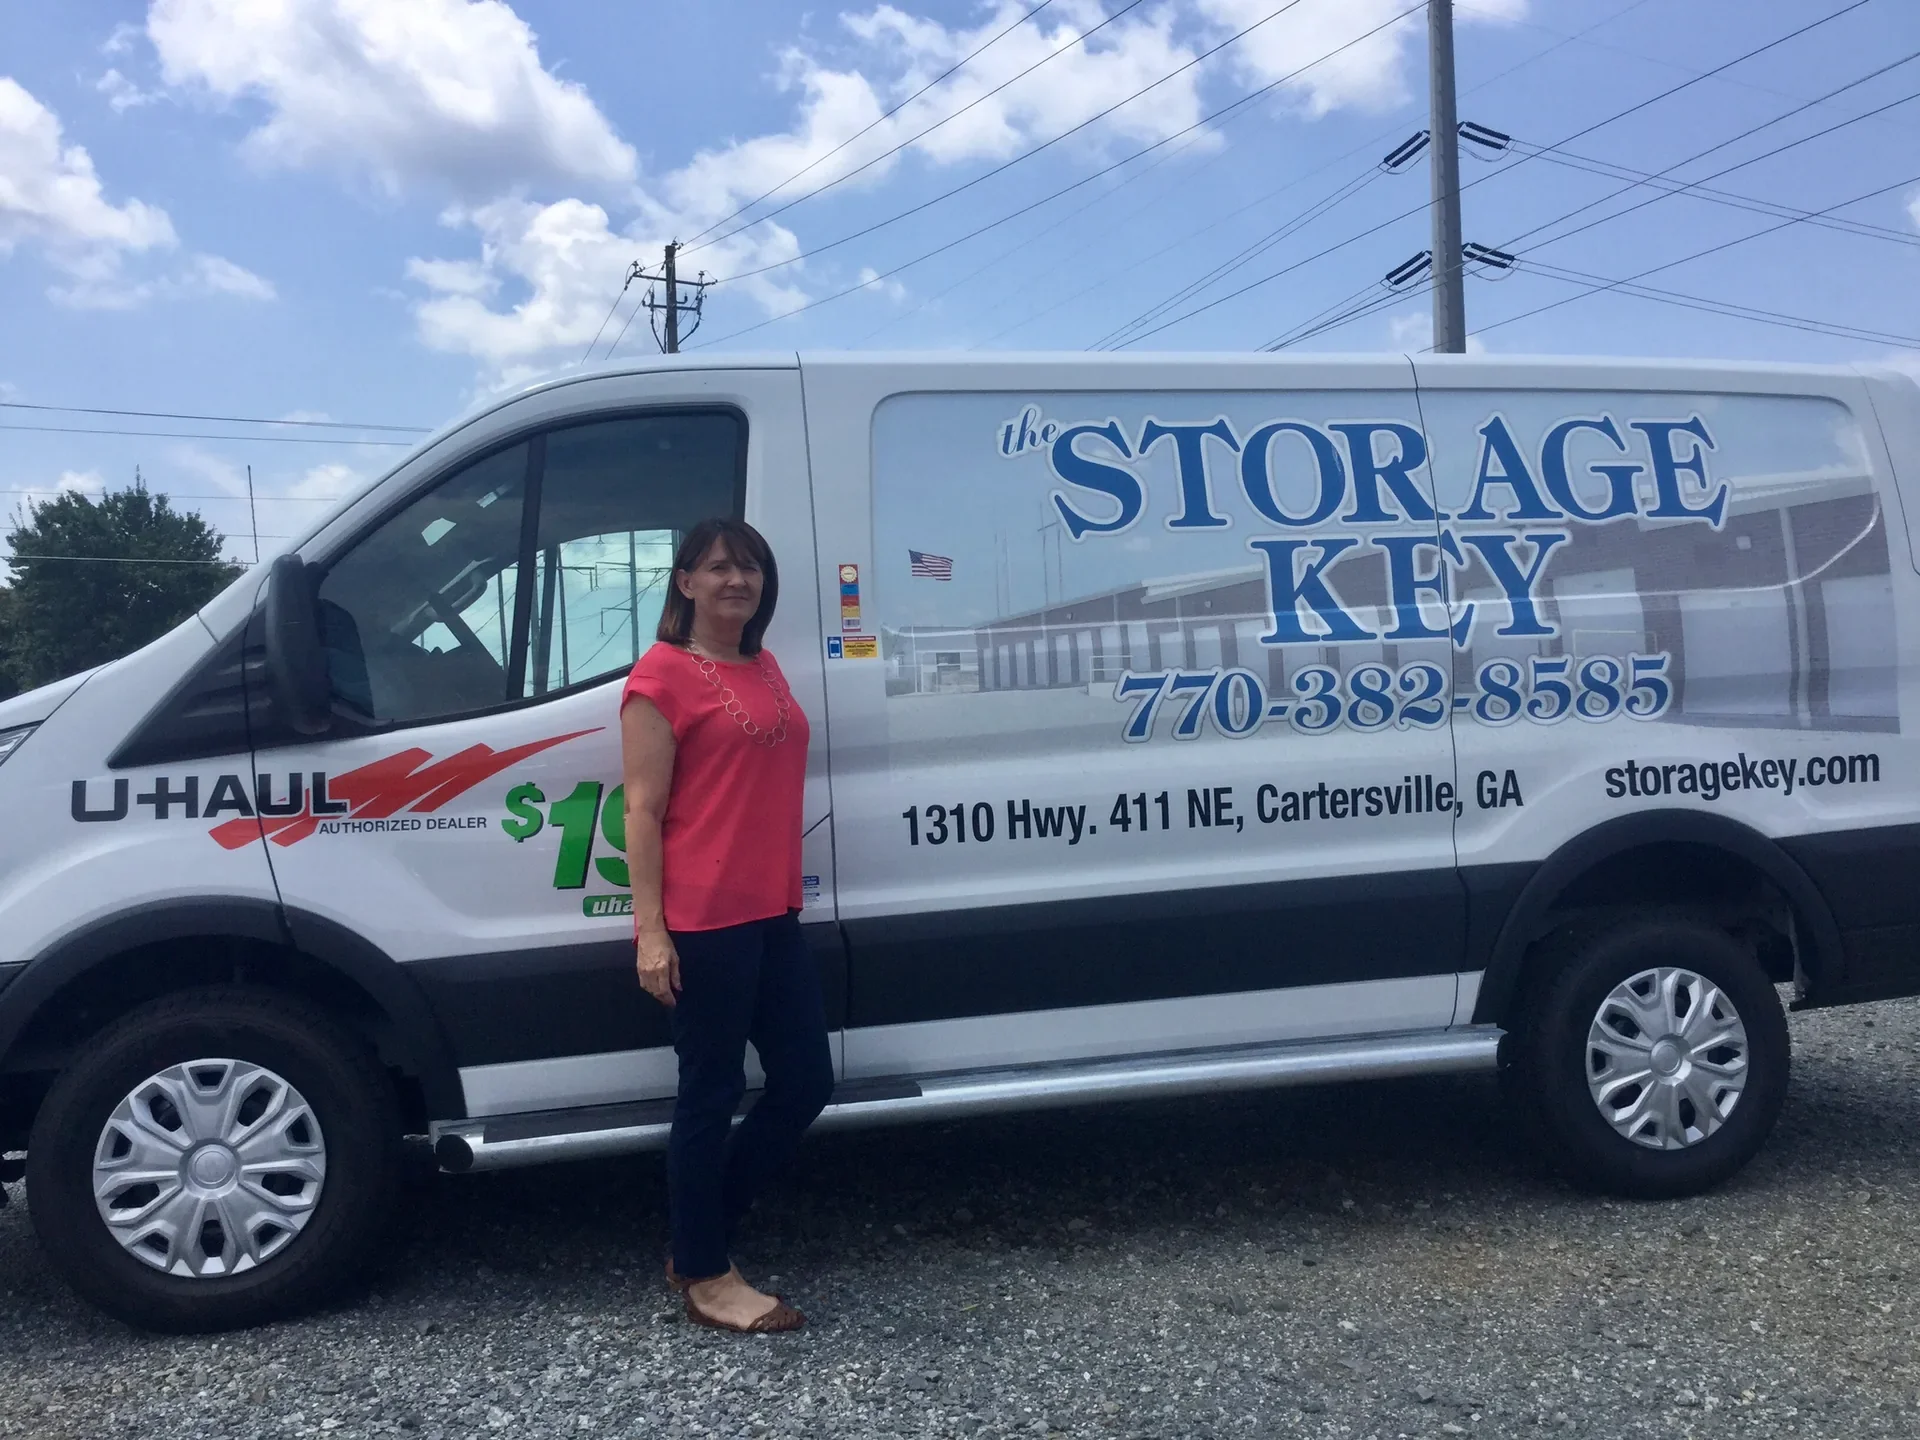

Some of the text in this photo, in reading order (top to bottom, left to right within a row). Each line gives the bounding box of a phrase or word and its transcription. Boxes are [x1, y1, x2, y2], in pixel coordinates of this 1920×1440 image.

[1001, 407, 1727, 539] the STORAGE
[1251, 530, 1566, 648] KEY
[1121, 658, 1670, 738] 770-382-8585
[902, 769, 1524, 846] 1310 Hwy. 411 NE, Cartersville, GA
[1605, 752, 1880, 801] storagekey.com
[319, 817, 487, 835] AUTHORIZED DEALER
